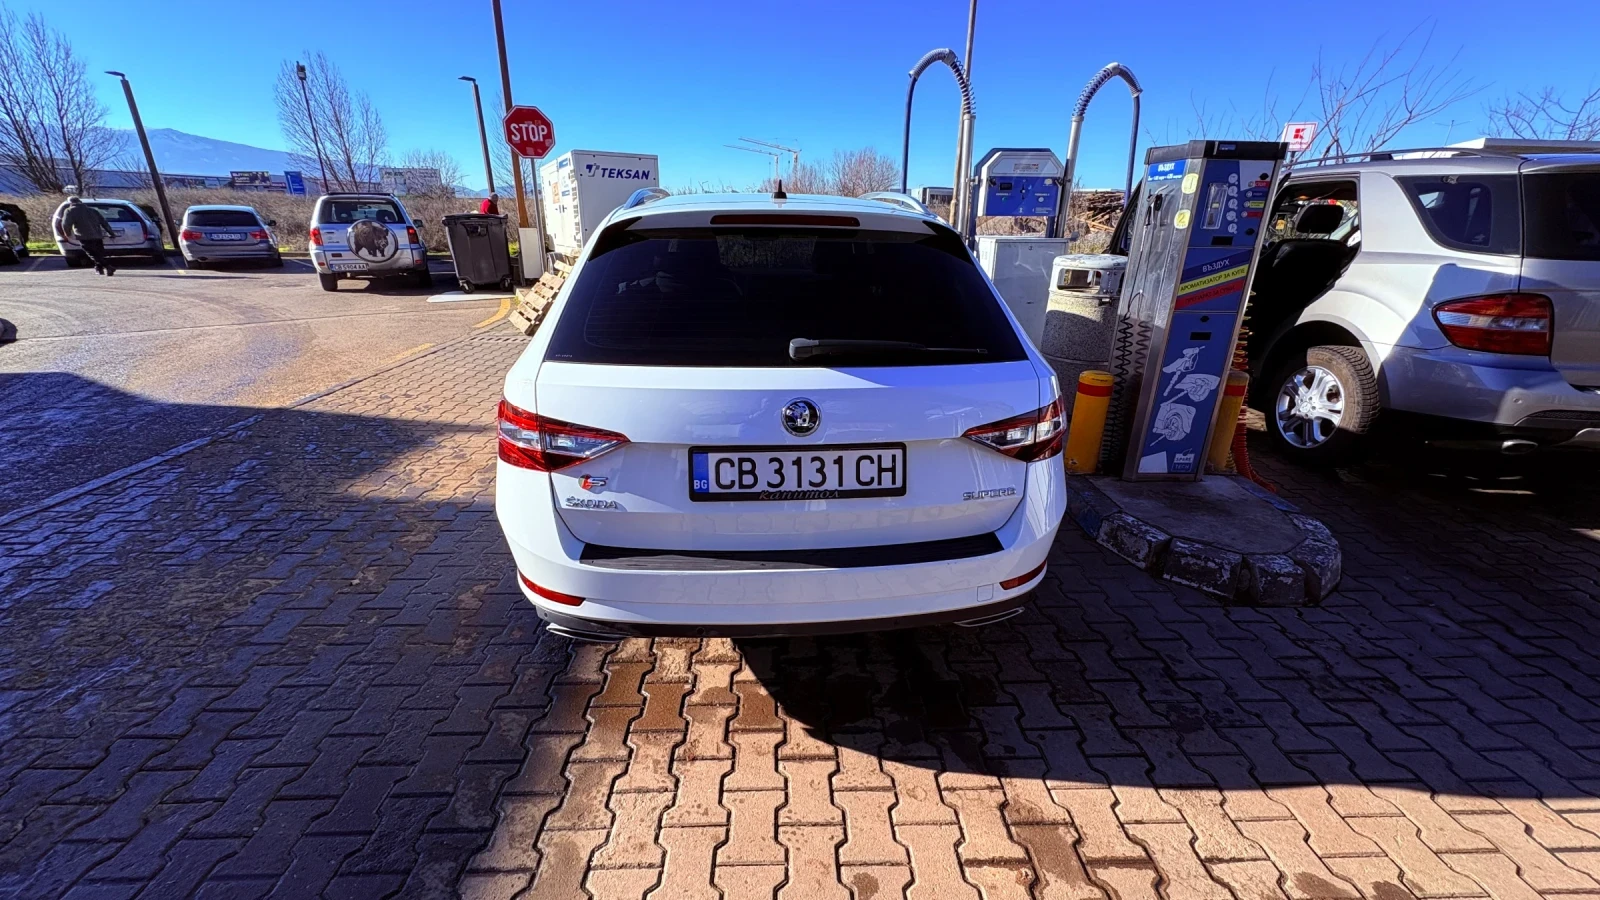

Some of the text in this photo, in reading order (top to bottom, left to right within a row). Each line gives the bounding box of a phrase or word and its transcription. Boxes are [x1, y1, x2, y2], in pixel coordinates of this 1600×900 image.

[510, 123, 548, 142] STOP
[601, 167, 650, 180] TEKSAN
[1202, 258, 1230, 273] ВЪЗДУХ
[1180, 275, 1223, 292] АРОМАТИЗАТОР
[1231, 268, 1246, 278] КУПЕ
[693, 454, 897, 490] BG CB 3131 CH
[962, 486, 1017, 501] SUPERB
